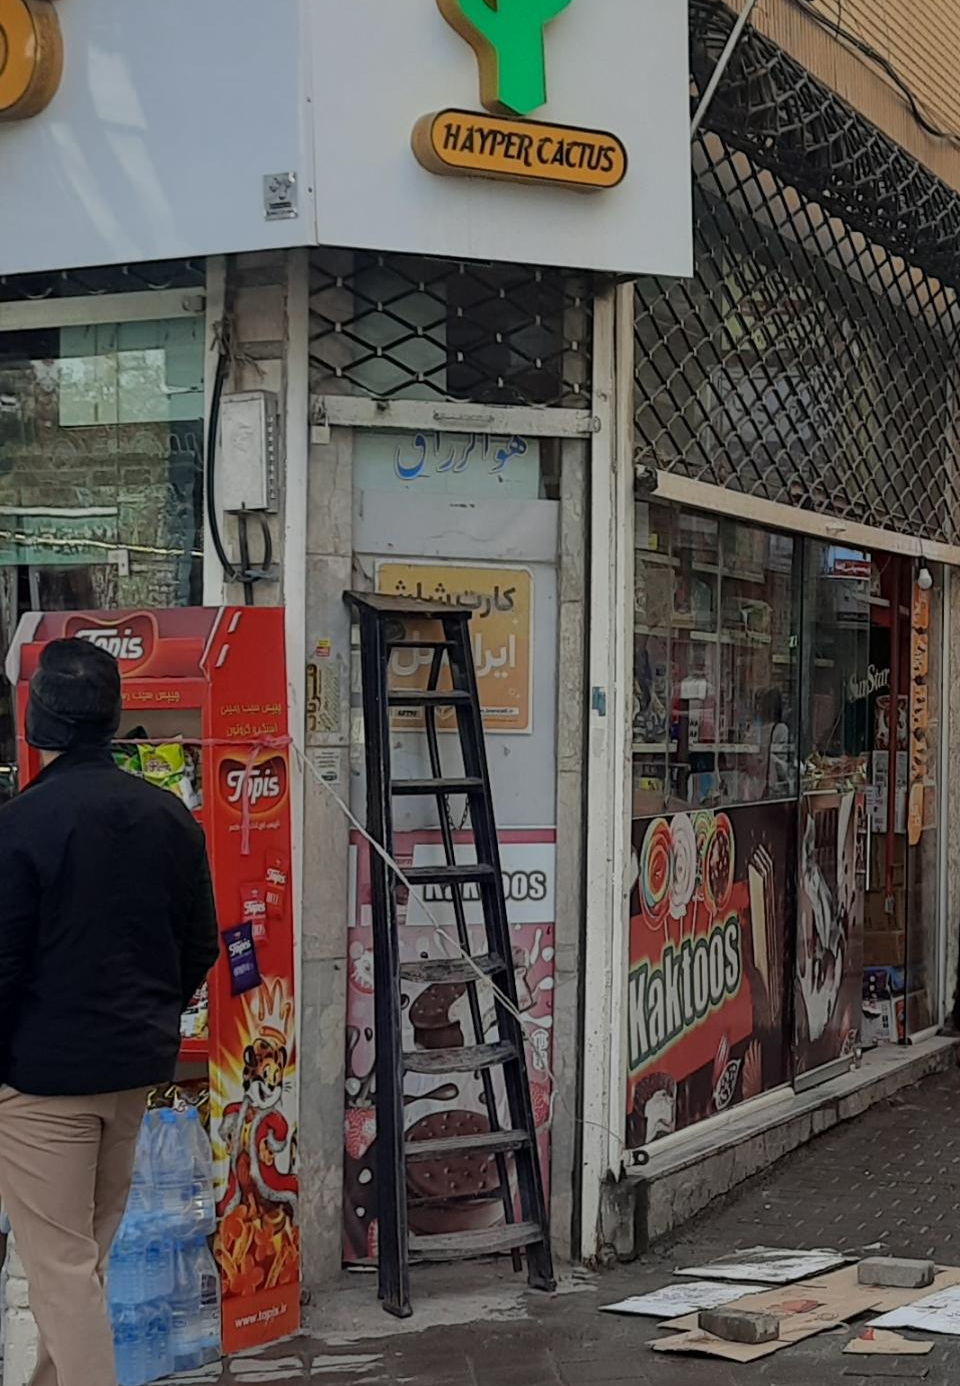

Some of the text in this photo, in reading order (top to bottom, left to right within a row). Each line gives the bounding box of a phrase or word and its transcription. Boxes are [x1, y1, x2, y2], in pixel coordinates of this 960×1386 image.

[444, 123, 616, 172] HAYPER CACTUS
[456, 586, 516, 618] کارت
[227, 768, 280, 804] Topis
[629, 915, 741, 1071] Kaktoos
